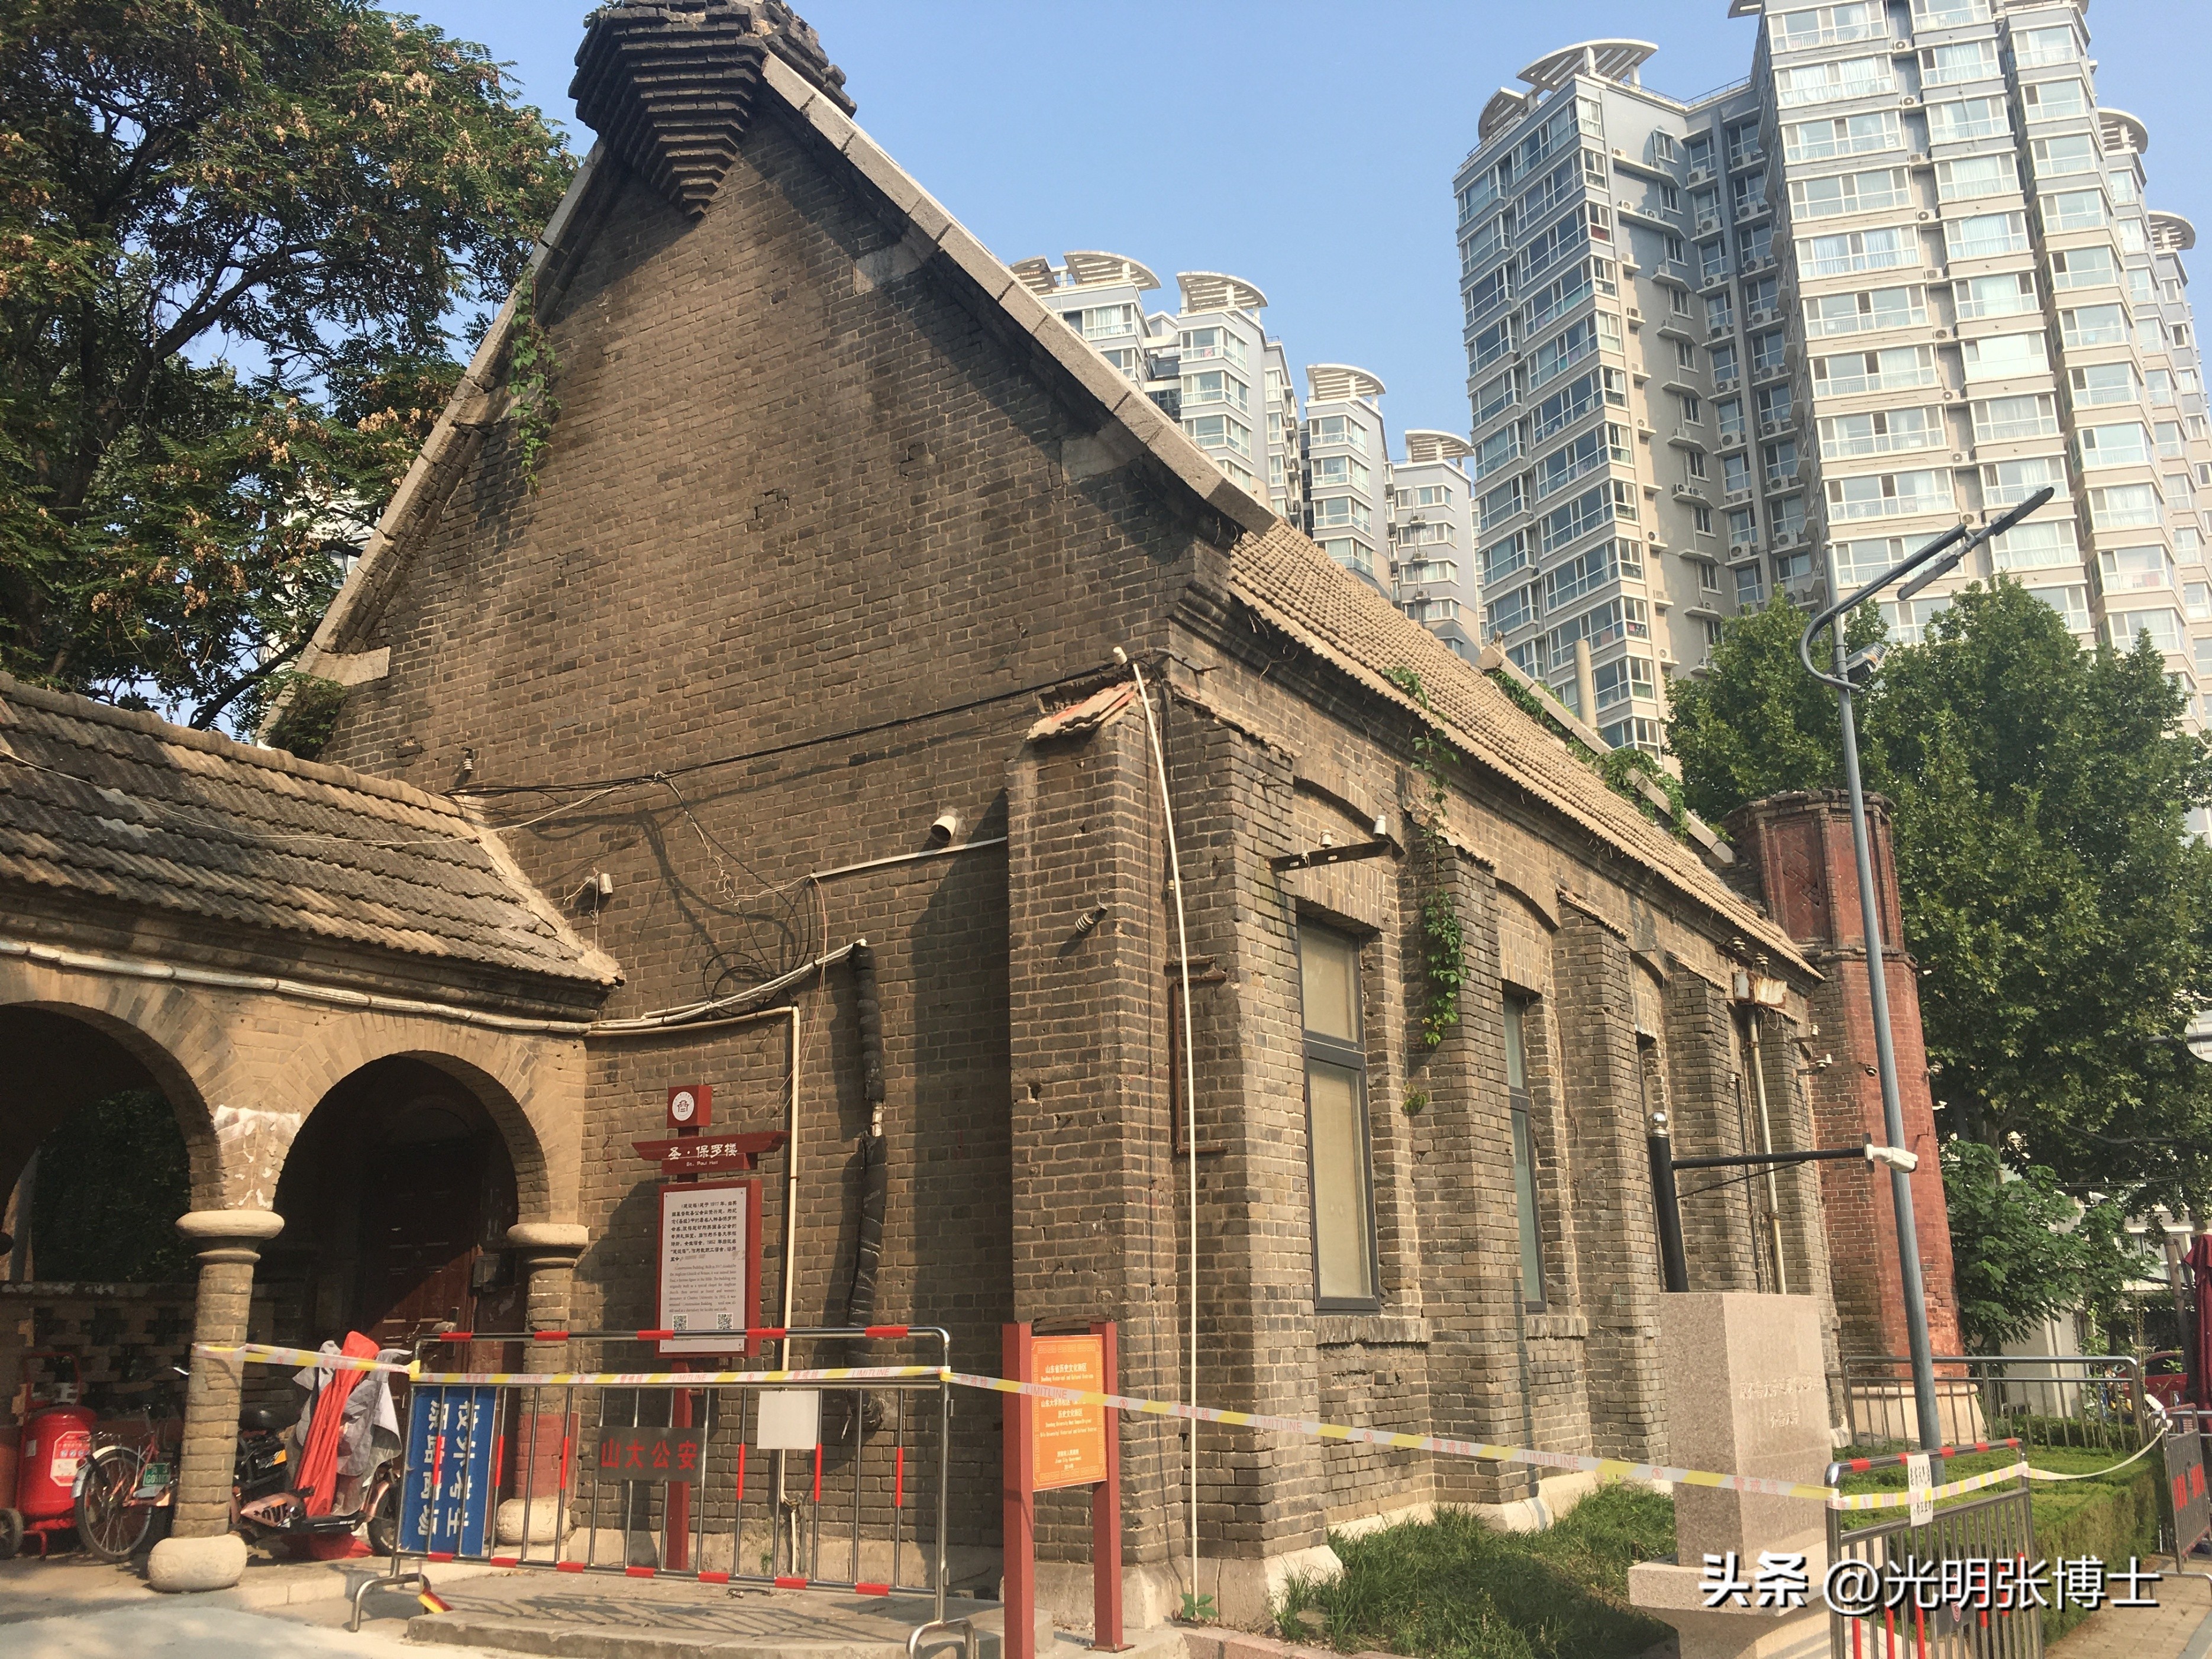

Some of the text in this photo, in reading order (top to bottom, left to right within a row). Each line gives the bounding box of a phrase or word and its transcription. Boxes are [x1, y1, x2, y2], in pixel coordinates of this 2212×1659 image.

[668, 1142, 738, 1161] 圣·保罗楼
[672, 1373, 707, 1383] LIMITLINE
[851, 1368, 890, 1378] LIMITLINE
[1025, 1384, 1067, 1400] LIMITLINE
[1178, 1405, 1210, 1421] 警戒线
[1254, 1416, 1302, 1432] LIMITLINE
[600, 1438, 697, 1470] 山大公安
[1431, 1438, 1471, 1455] 警戒线
[1522, 1451, 1580, 1470] LIMITLINE
[1733, 1476, 1779, 1495] 警戒线
